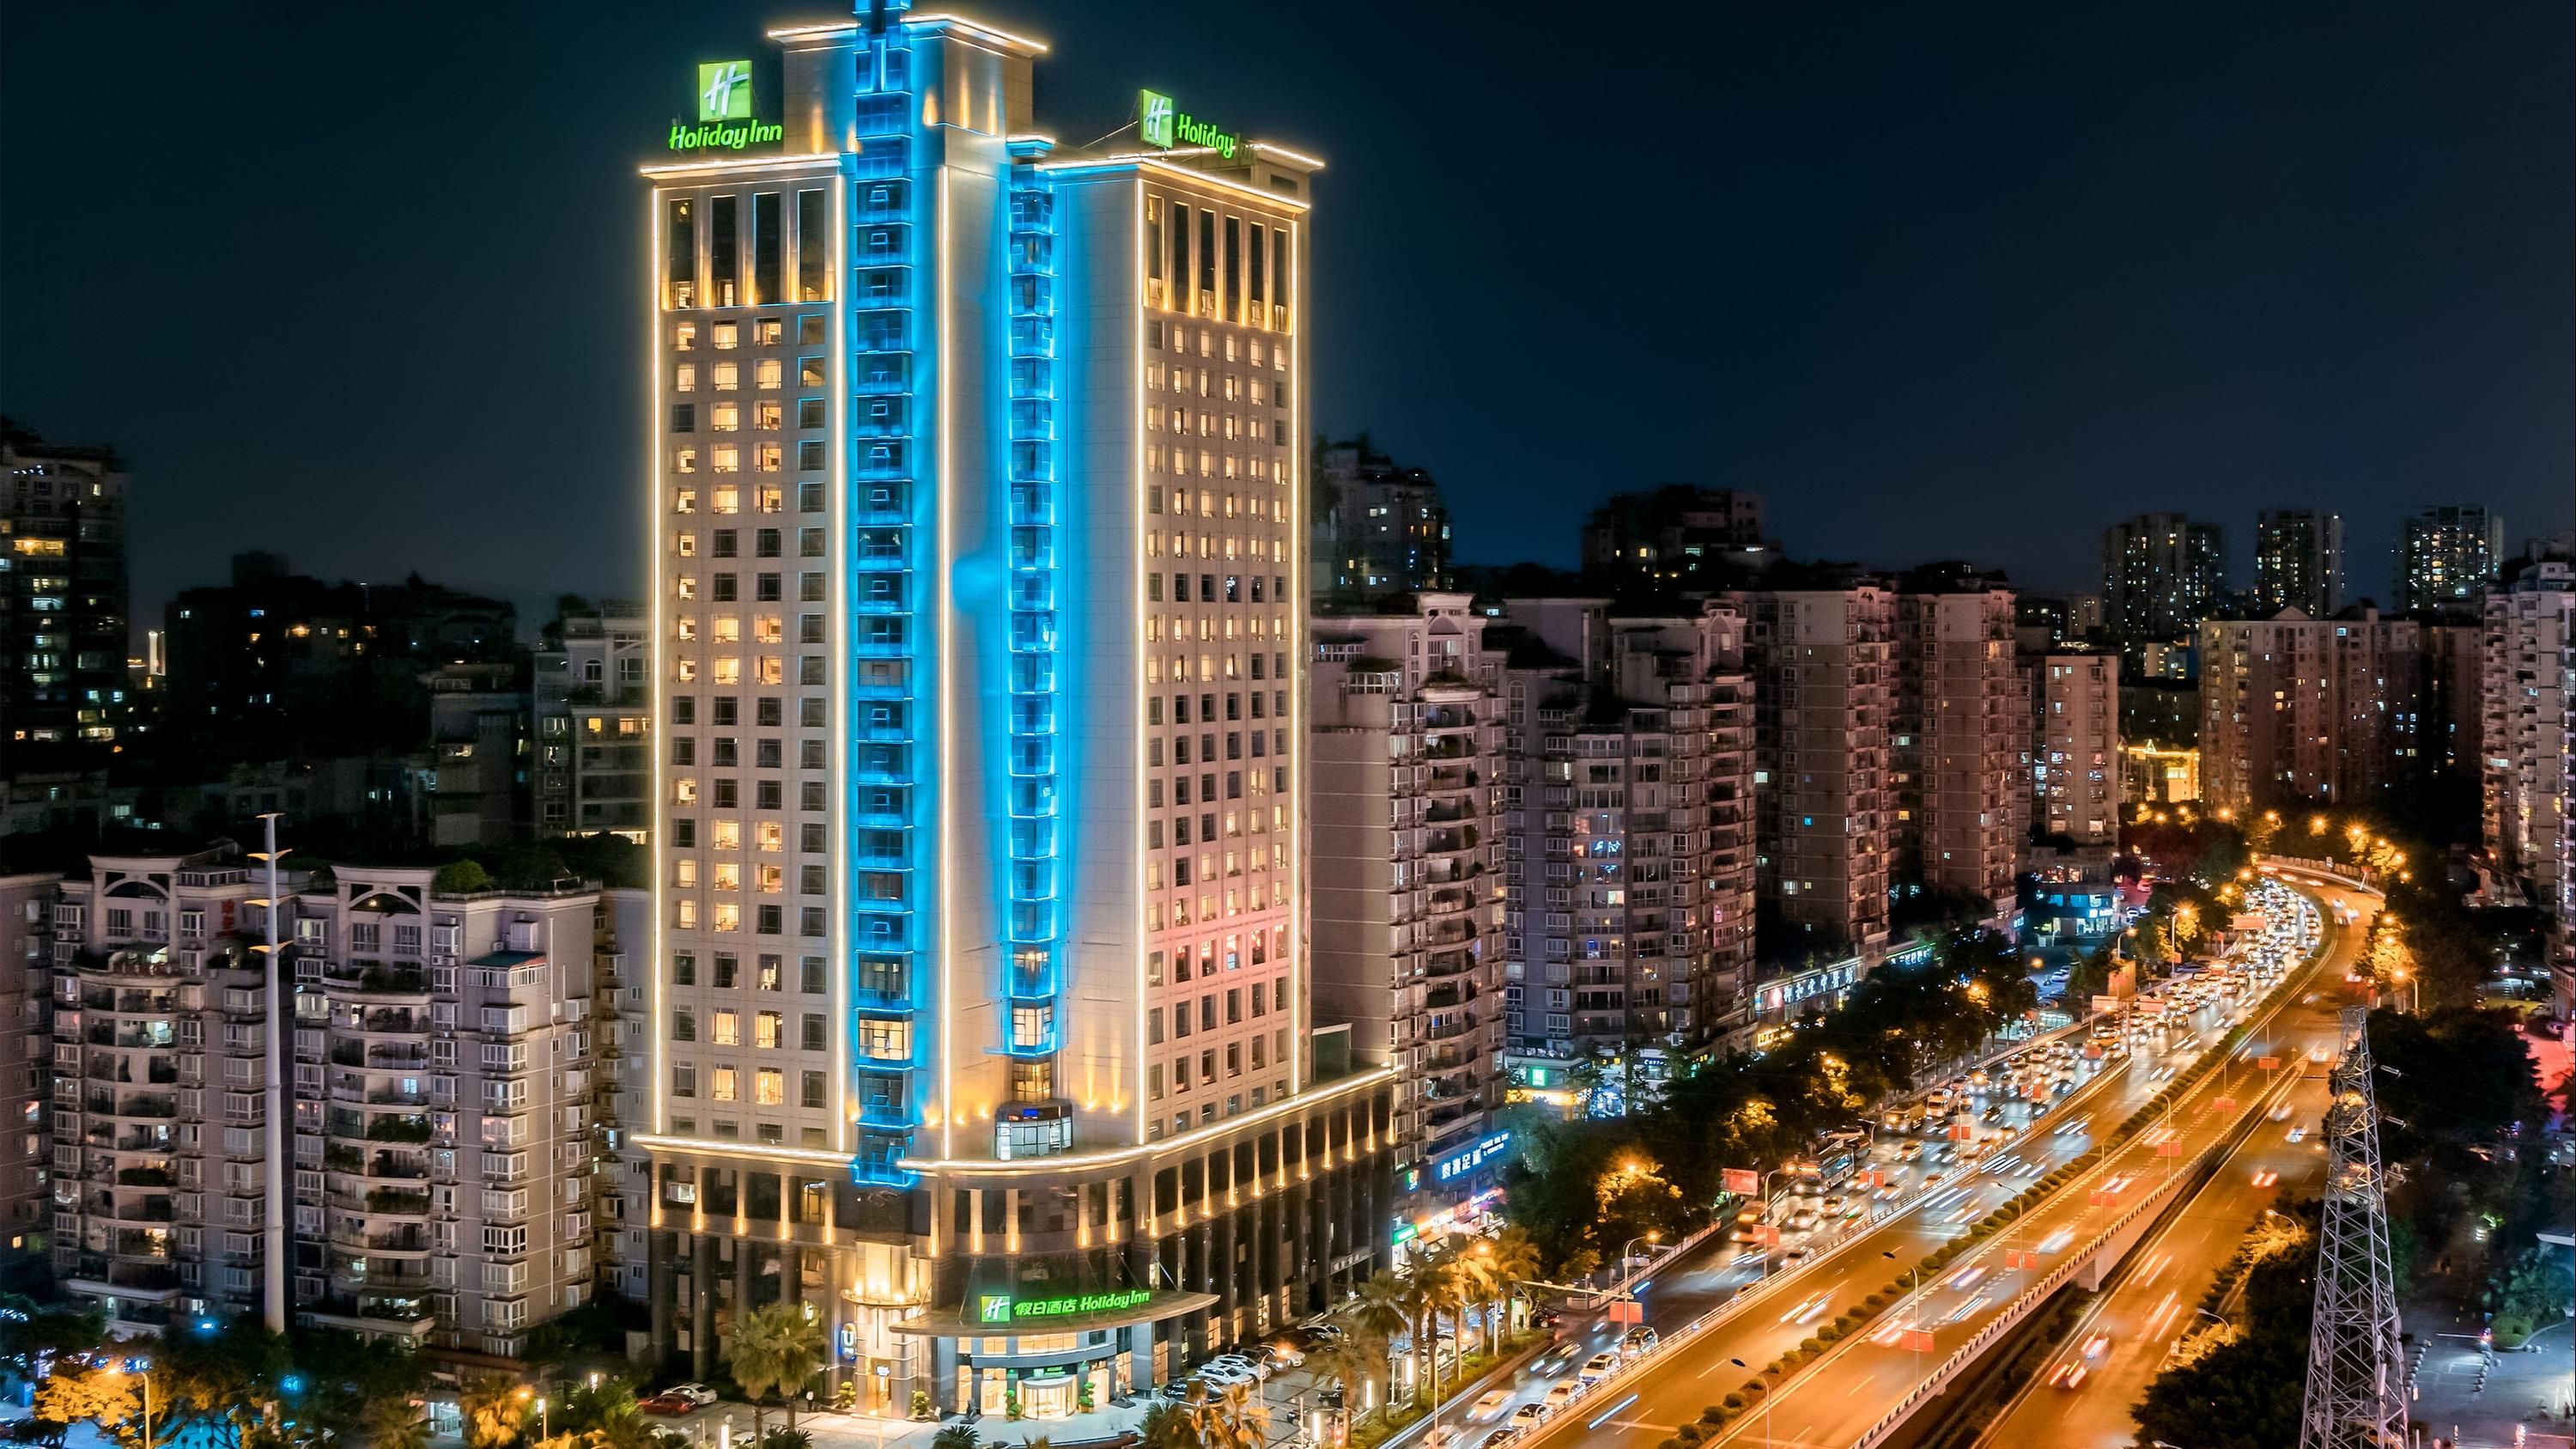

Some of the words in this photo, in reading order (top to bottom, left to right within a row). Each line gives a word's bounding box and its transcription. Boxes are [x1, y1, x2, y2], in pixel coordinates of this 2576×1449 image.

[668, 123, 748, 149] Holiday
[750, 119, 783, 143] Inn
[1178, 113, 1235, 159] Holiday
[1014, 1299, 1078, 1316] 假日酒店
[1079, 1293, 1130, 1311] Holiday
[1130, 1290, 1151, 1304] Inn
